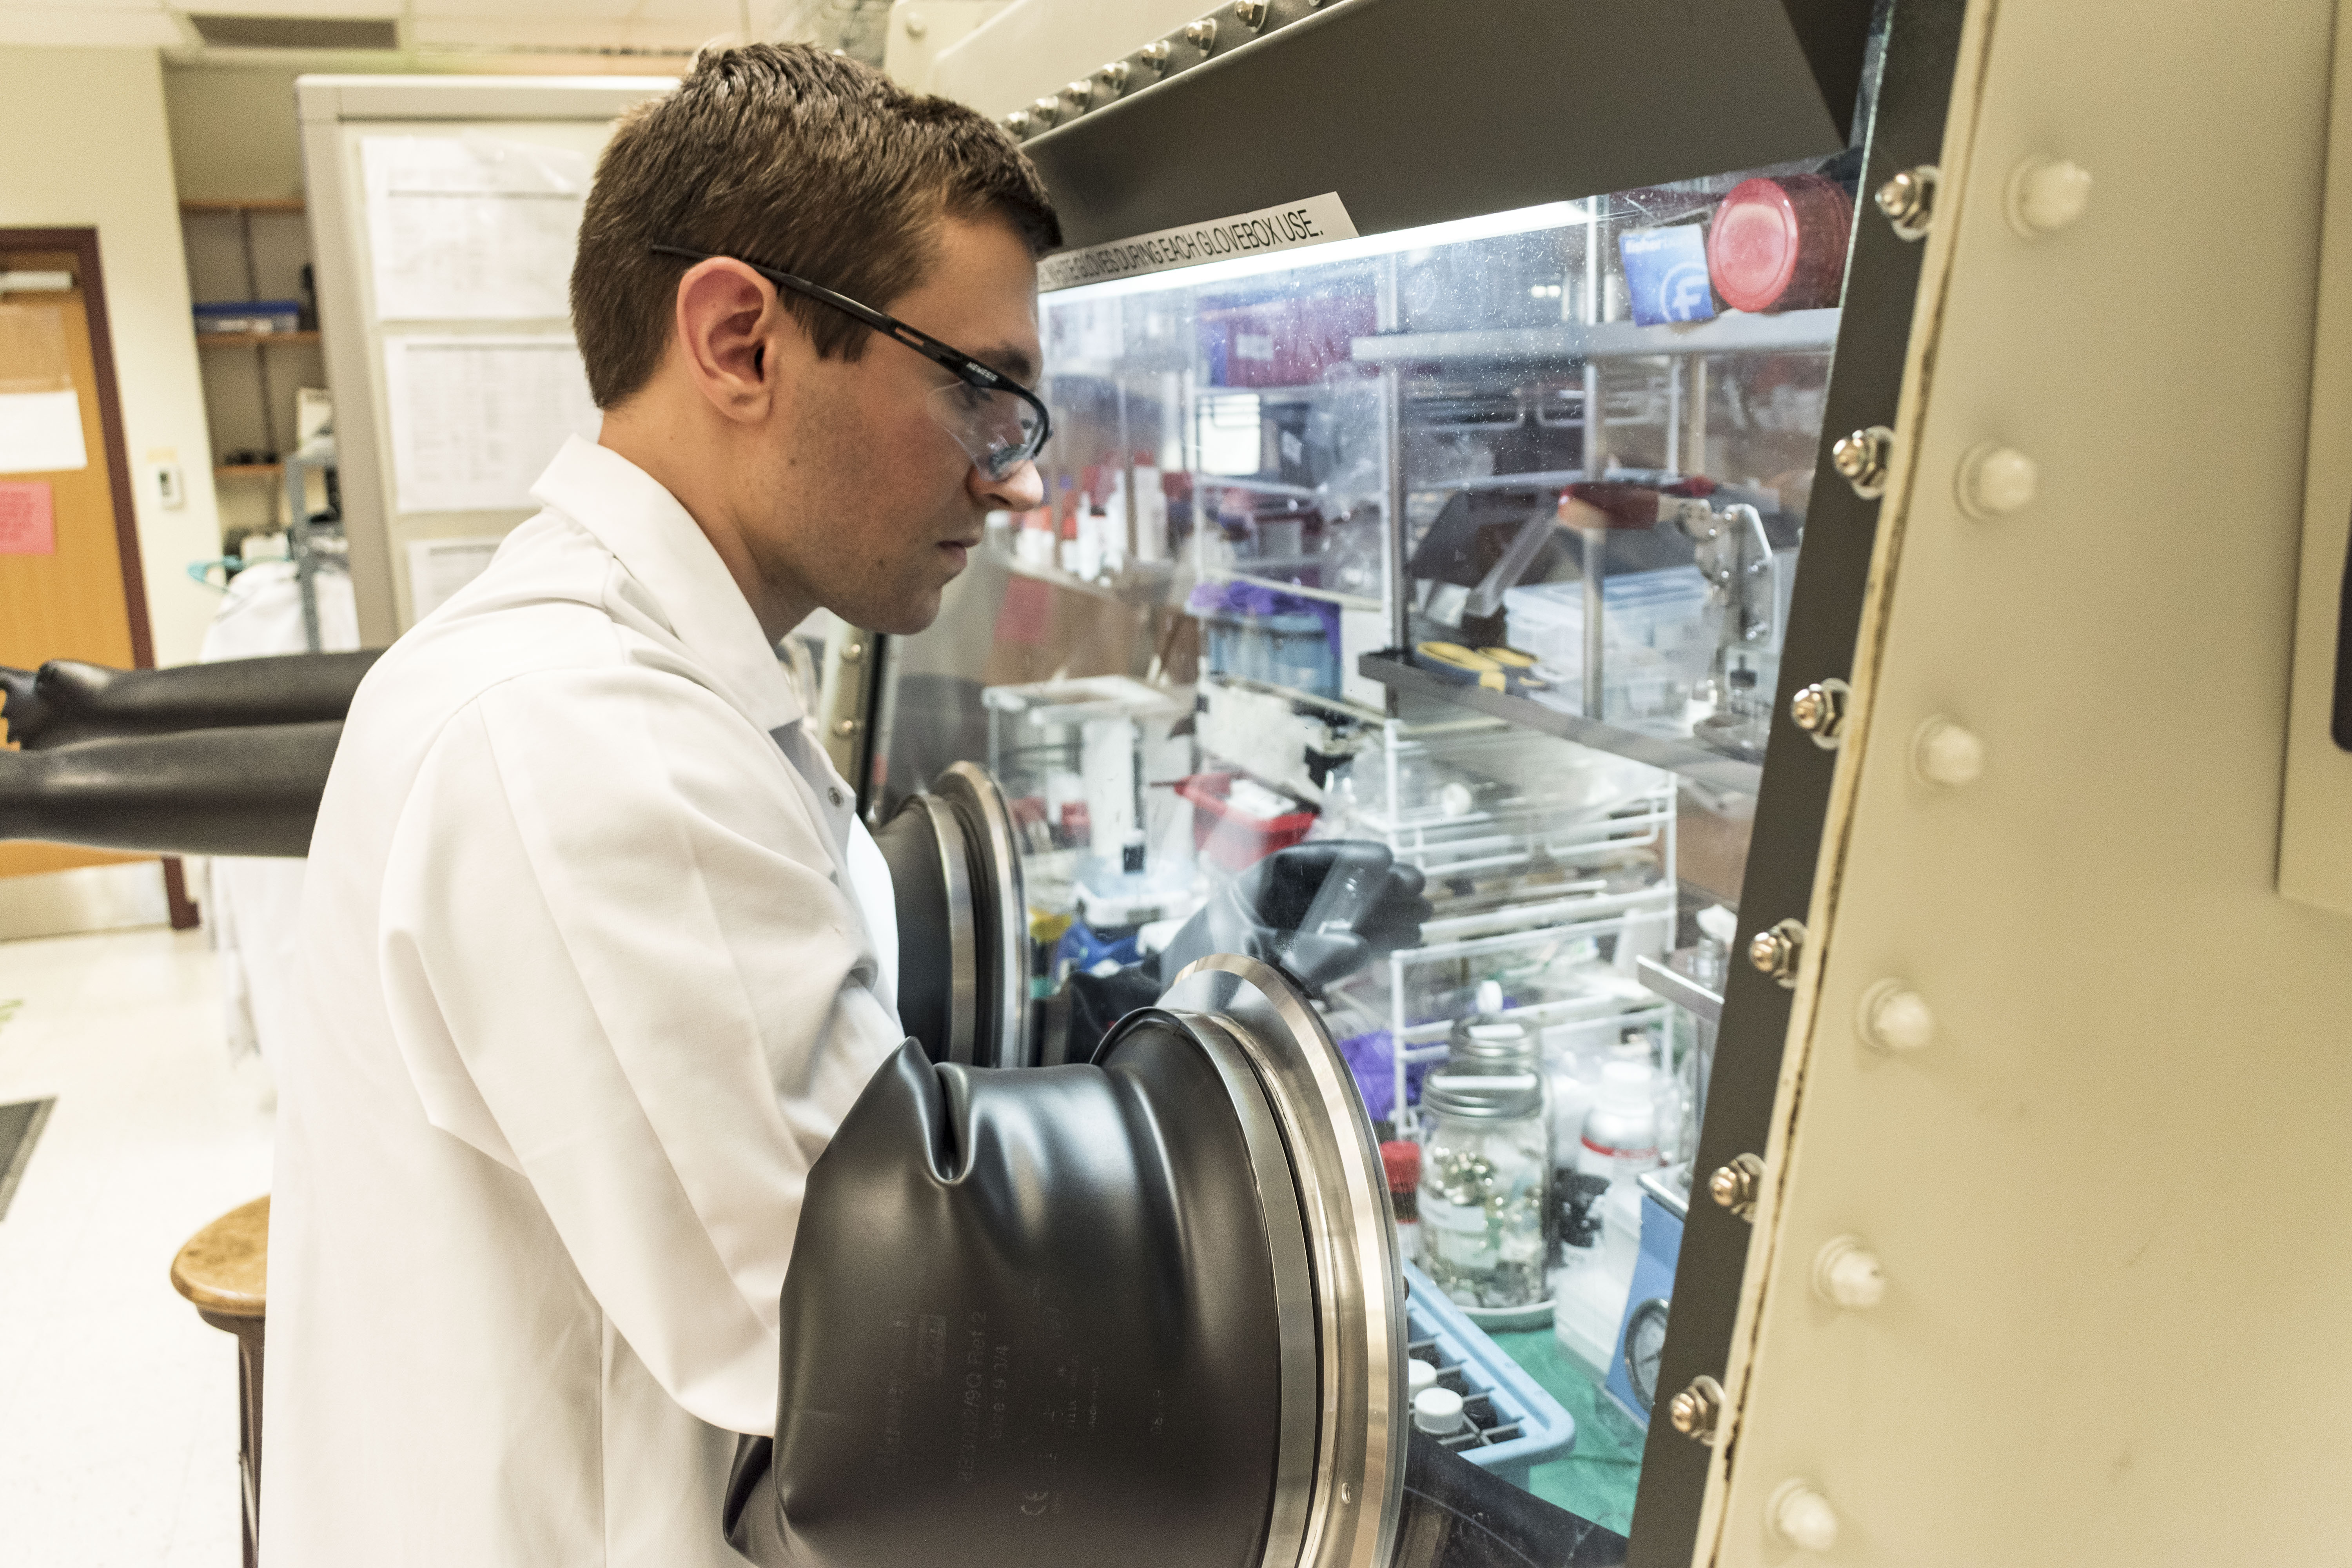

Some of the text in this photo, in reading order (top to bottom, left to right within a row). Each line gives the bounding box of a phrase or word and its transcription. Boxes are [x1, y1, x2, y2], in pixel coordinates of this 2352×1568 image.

[1074, 249, 1120, 277] GLOVES
[1114, 240, 1163, 270] DURING
[1159, 233, 1201, 262] EACH
[1196, 217, 1283, 256] GLOVEBOX
[1276, 209, 1324, 242] USE.
[970, 1311, 987, 1323] 2
[966, 1329, 985, 1364] Ref
[993, 1344, 1009, 1371] 3/4
[991, 1377, 1007, 1389] 9
